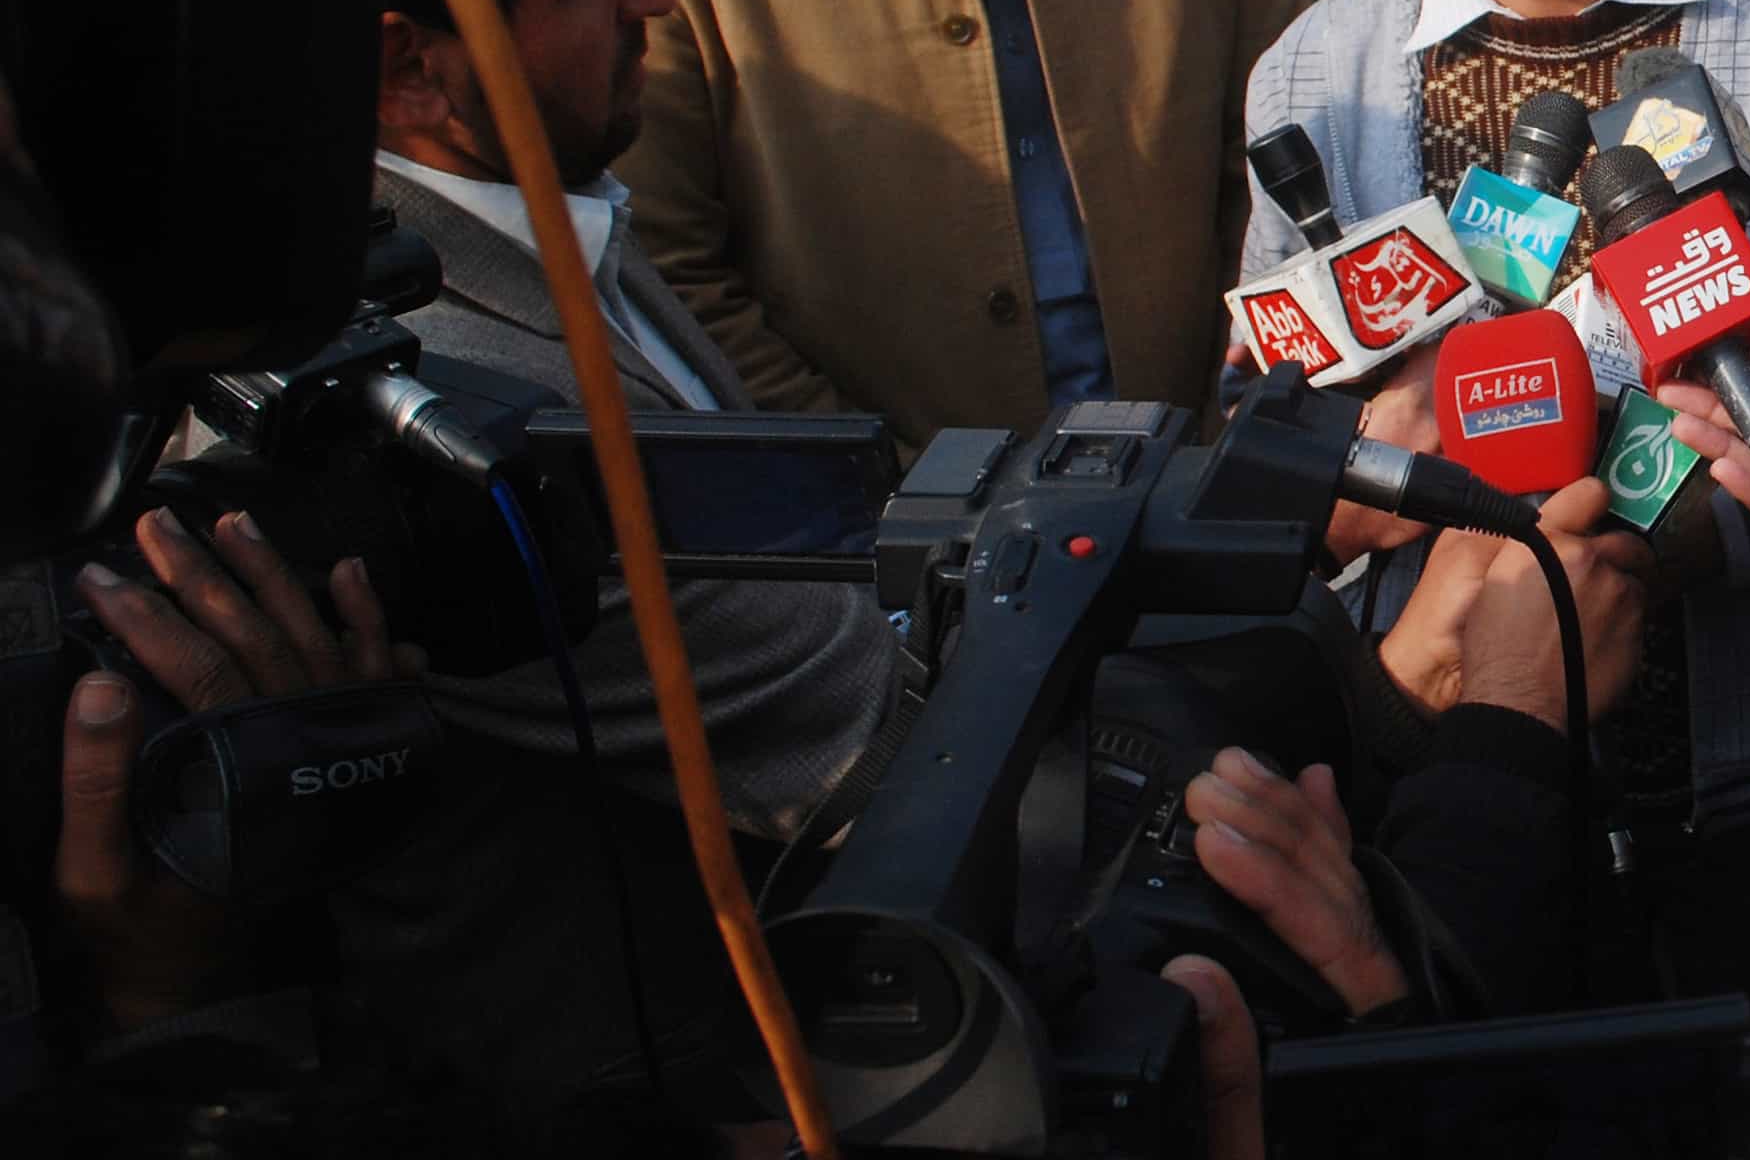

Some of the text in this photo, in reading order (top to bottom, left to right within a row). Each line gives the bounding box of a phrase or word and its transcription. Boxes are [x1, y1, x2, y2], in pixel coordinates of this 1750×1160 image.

[1462, 196, 1557, 256] DAWN
[1645, 226, 1733, 292] وقت
[1250, 299, 1304, 345] Abb
[1468, 374, 1544, 405] A-Lite
[290, 746, 410, 796] SONY
